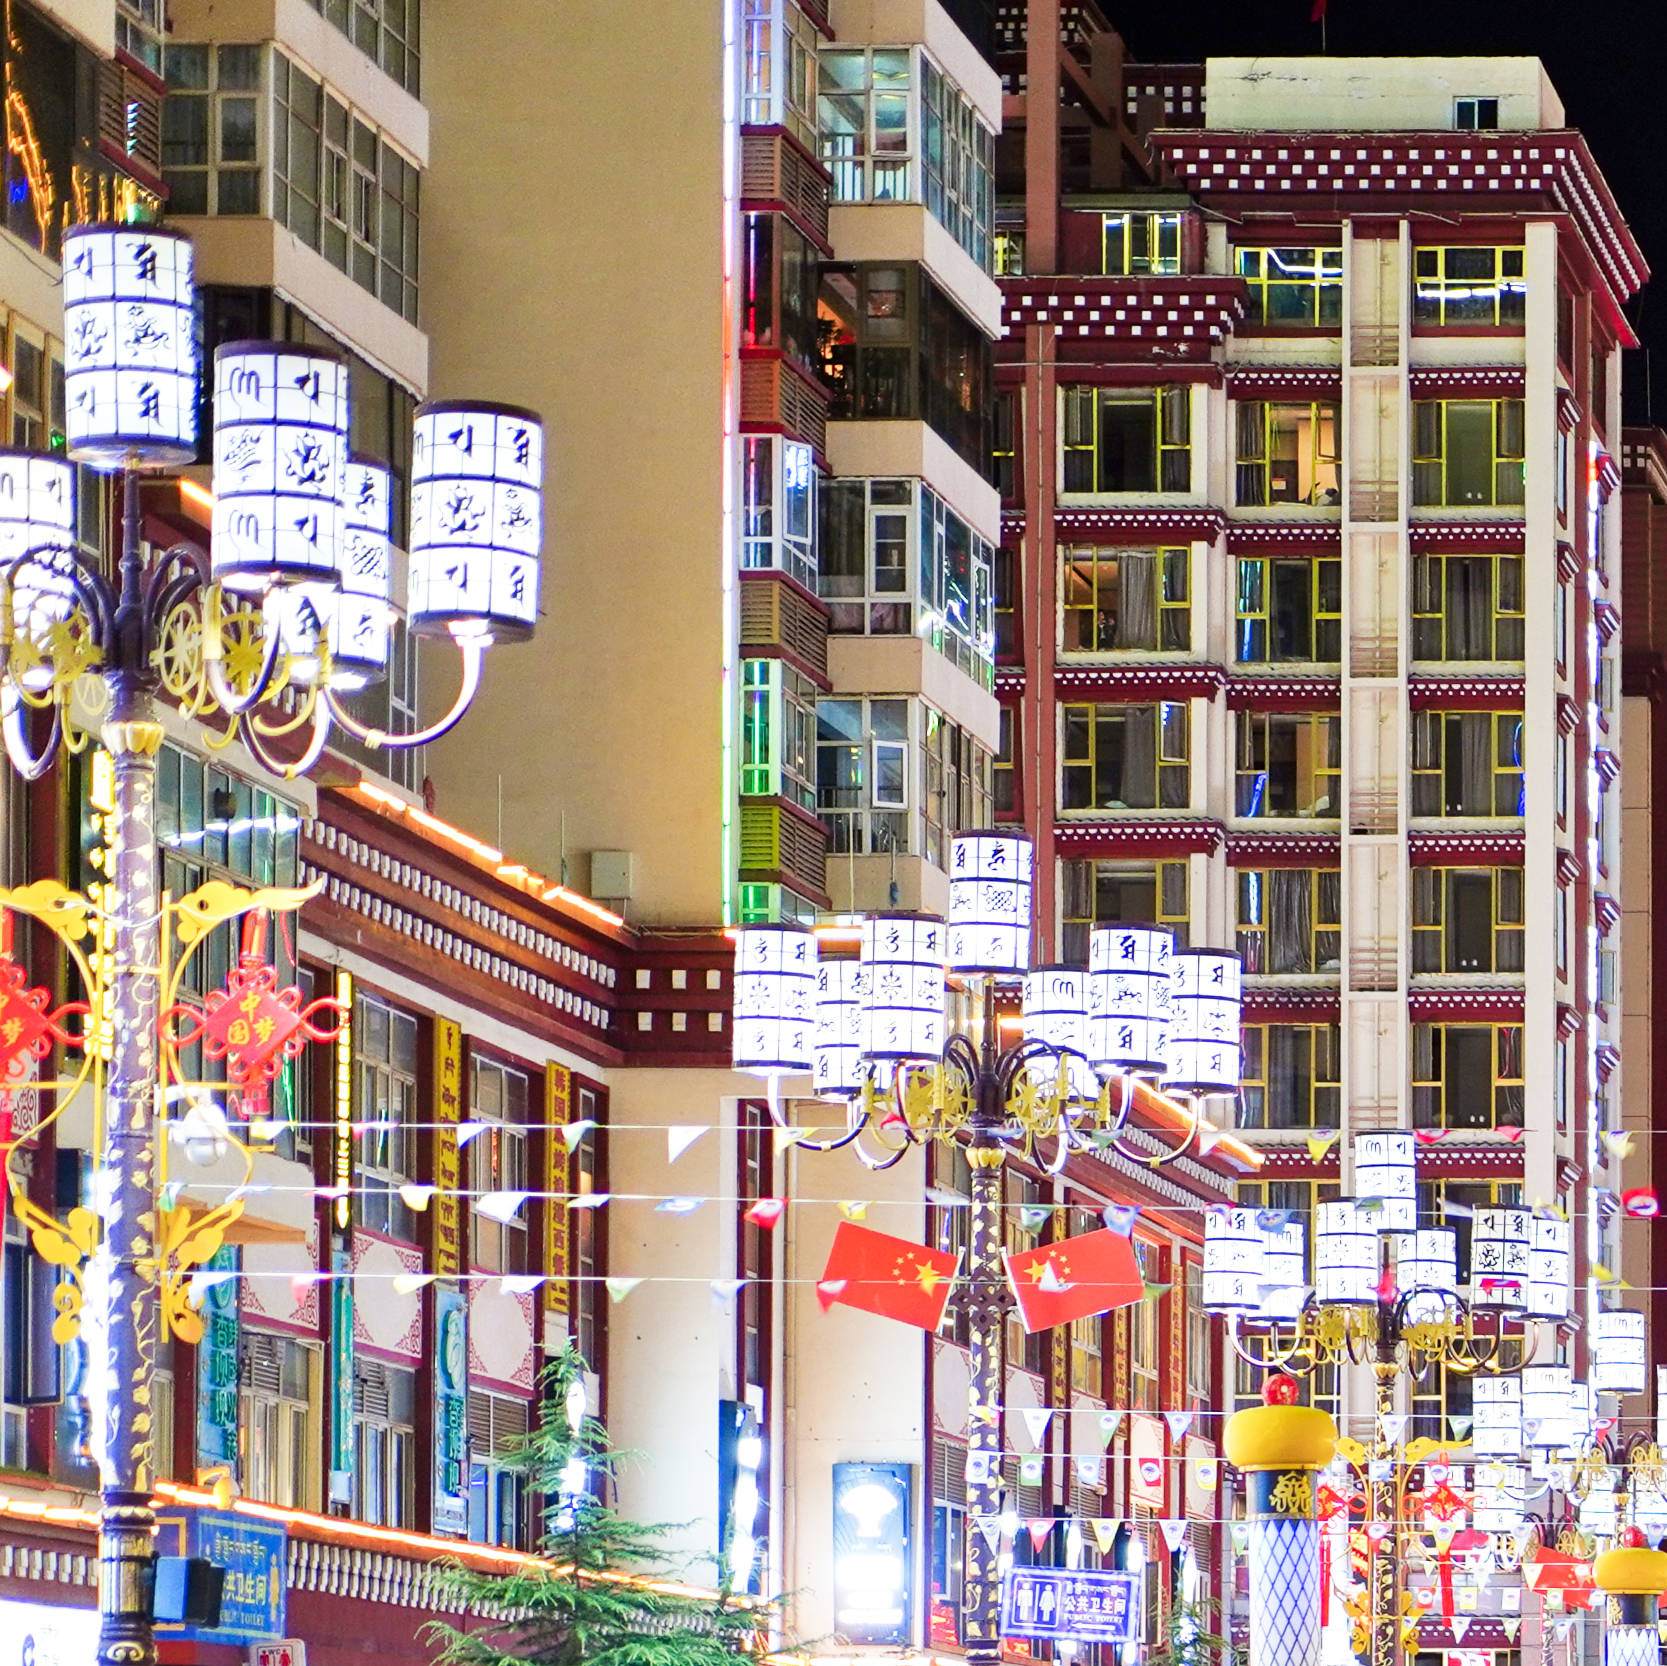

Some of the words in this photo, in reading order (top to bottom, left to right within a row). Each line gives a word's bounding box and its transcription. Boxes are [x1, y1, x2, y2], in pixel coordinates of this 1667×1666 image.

[222, 1570, 267, 1606] 共卫生间
[1063, 1597, 1127, 1615] 公共卫生间
